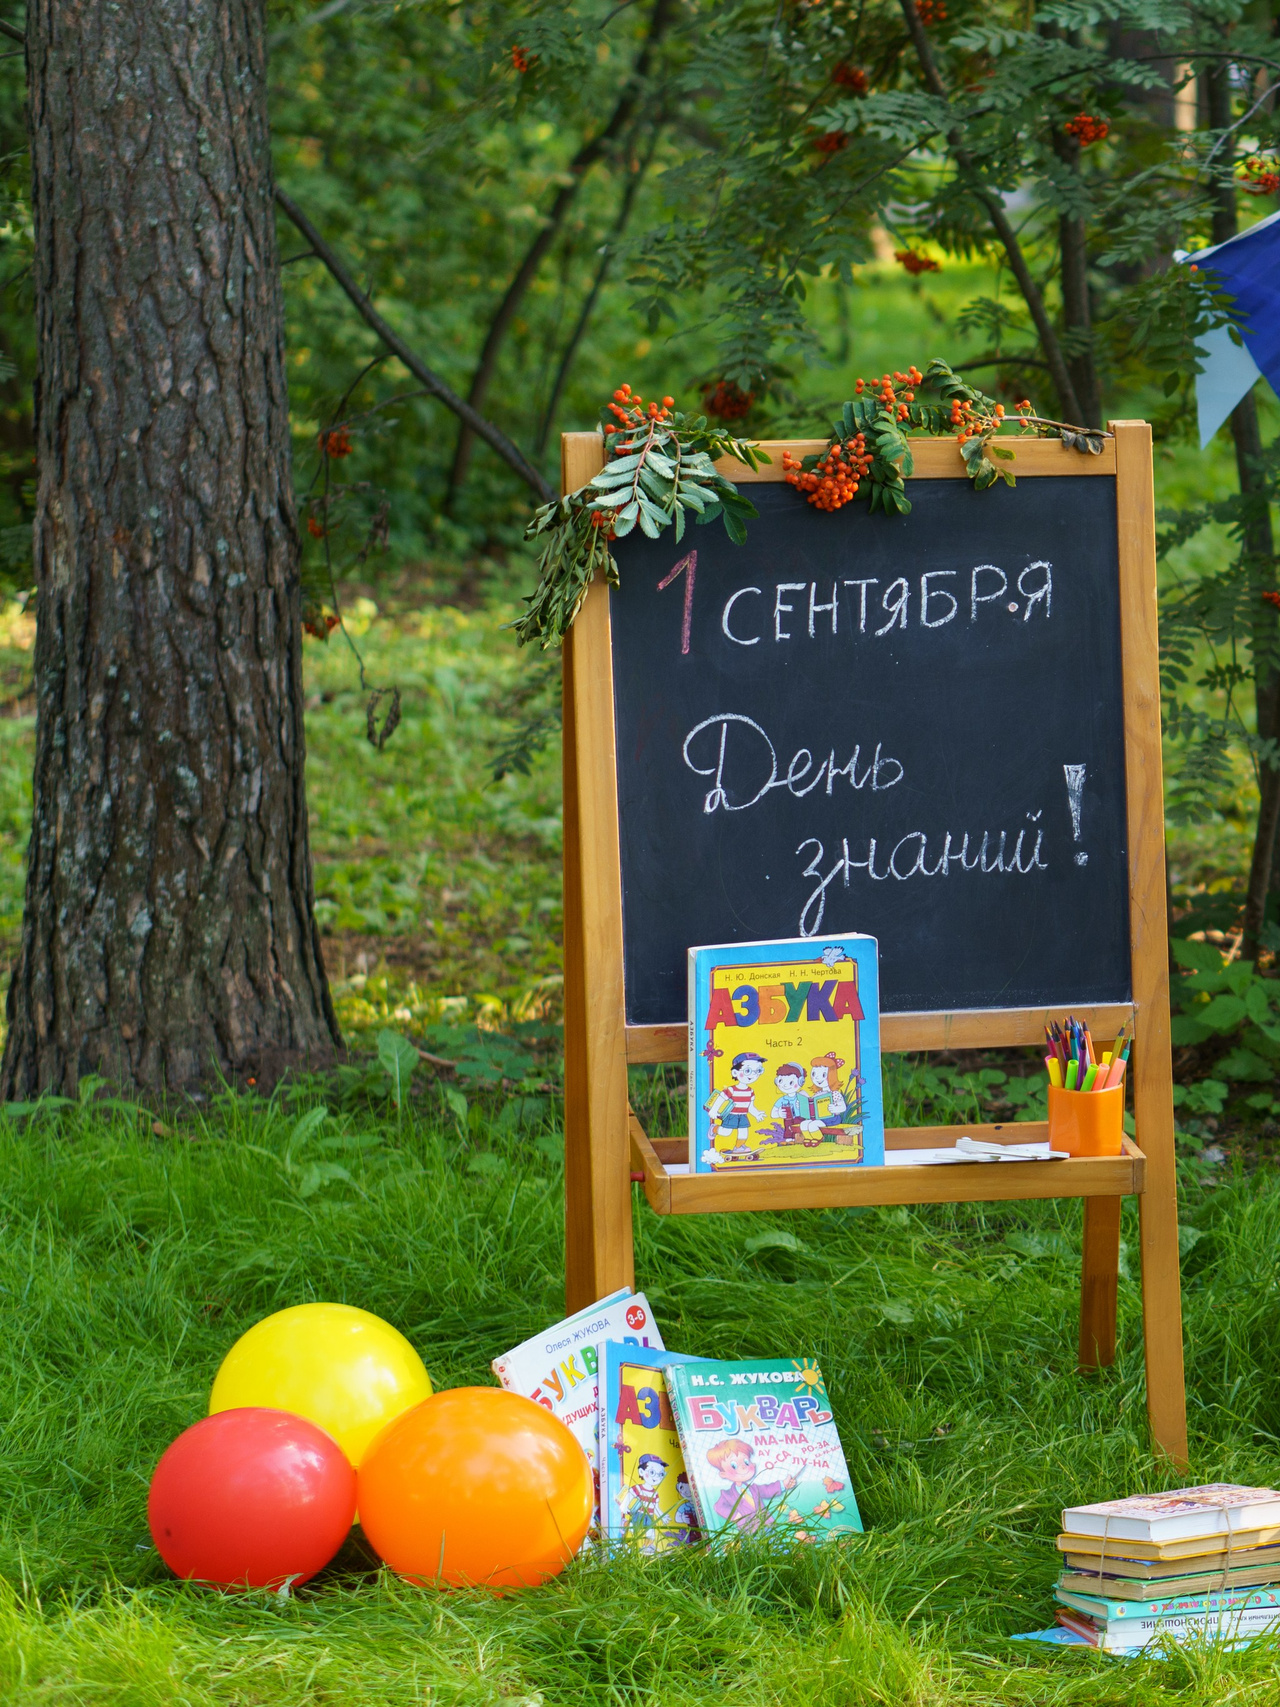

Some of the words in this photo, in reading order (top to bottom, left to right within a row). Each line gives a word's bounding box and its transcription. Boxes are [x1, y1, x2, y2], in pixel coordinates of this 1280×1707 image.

[656, 549, 697, 654] 1
[682, 712, 905, 815] День
[725, 974, 733, 982] Н.
[736, 972, 746, 981] Ю.
[749, 972, 781, 981] Донская
[811, 968, 842, 976] Чертова
[704, 979, 865, 1030] АЗБУКА
[765, 1038, 793, 1048] Часть
[797, 1036, 803, 1046] 2
[627, 1309, 644, 1325] 3-6
[545, 1337, 572, 1354] Олеся
[571, 1318, 611, 1343] ЖУКОВА
[529, 1336, 658, 1411] БУКВ
[691, 1374, 725, 1387] Н.С.
[729, 1371, 806, 1385] ЖУКОВА
[562, 1401, 598, 1426] ДУЩИХ
[615, 1384, 677, 1431] АЗБ
[754, 1433, 809, 1446] МА-МА
[801, 1440, 830, 1454] РО-ЗА
[758, 1449, 771, 1457] АУ
[764, 1450, 792, 1470] О-СА
[792, 1457, 830, 1468] ЛУ-НА
